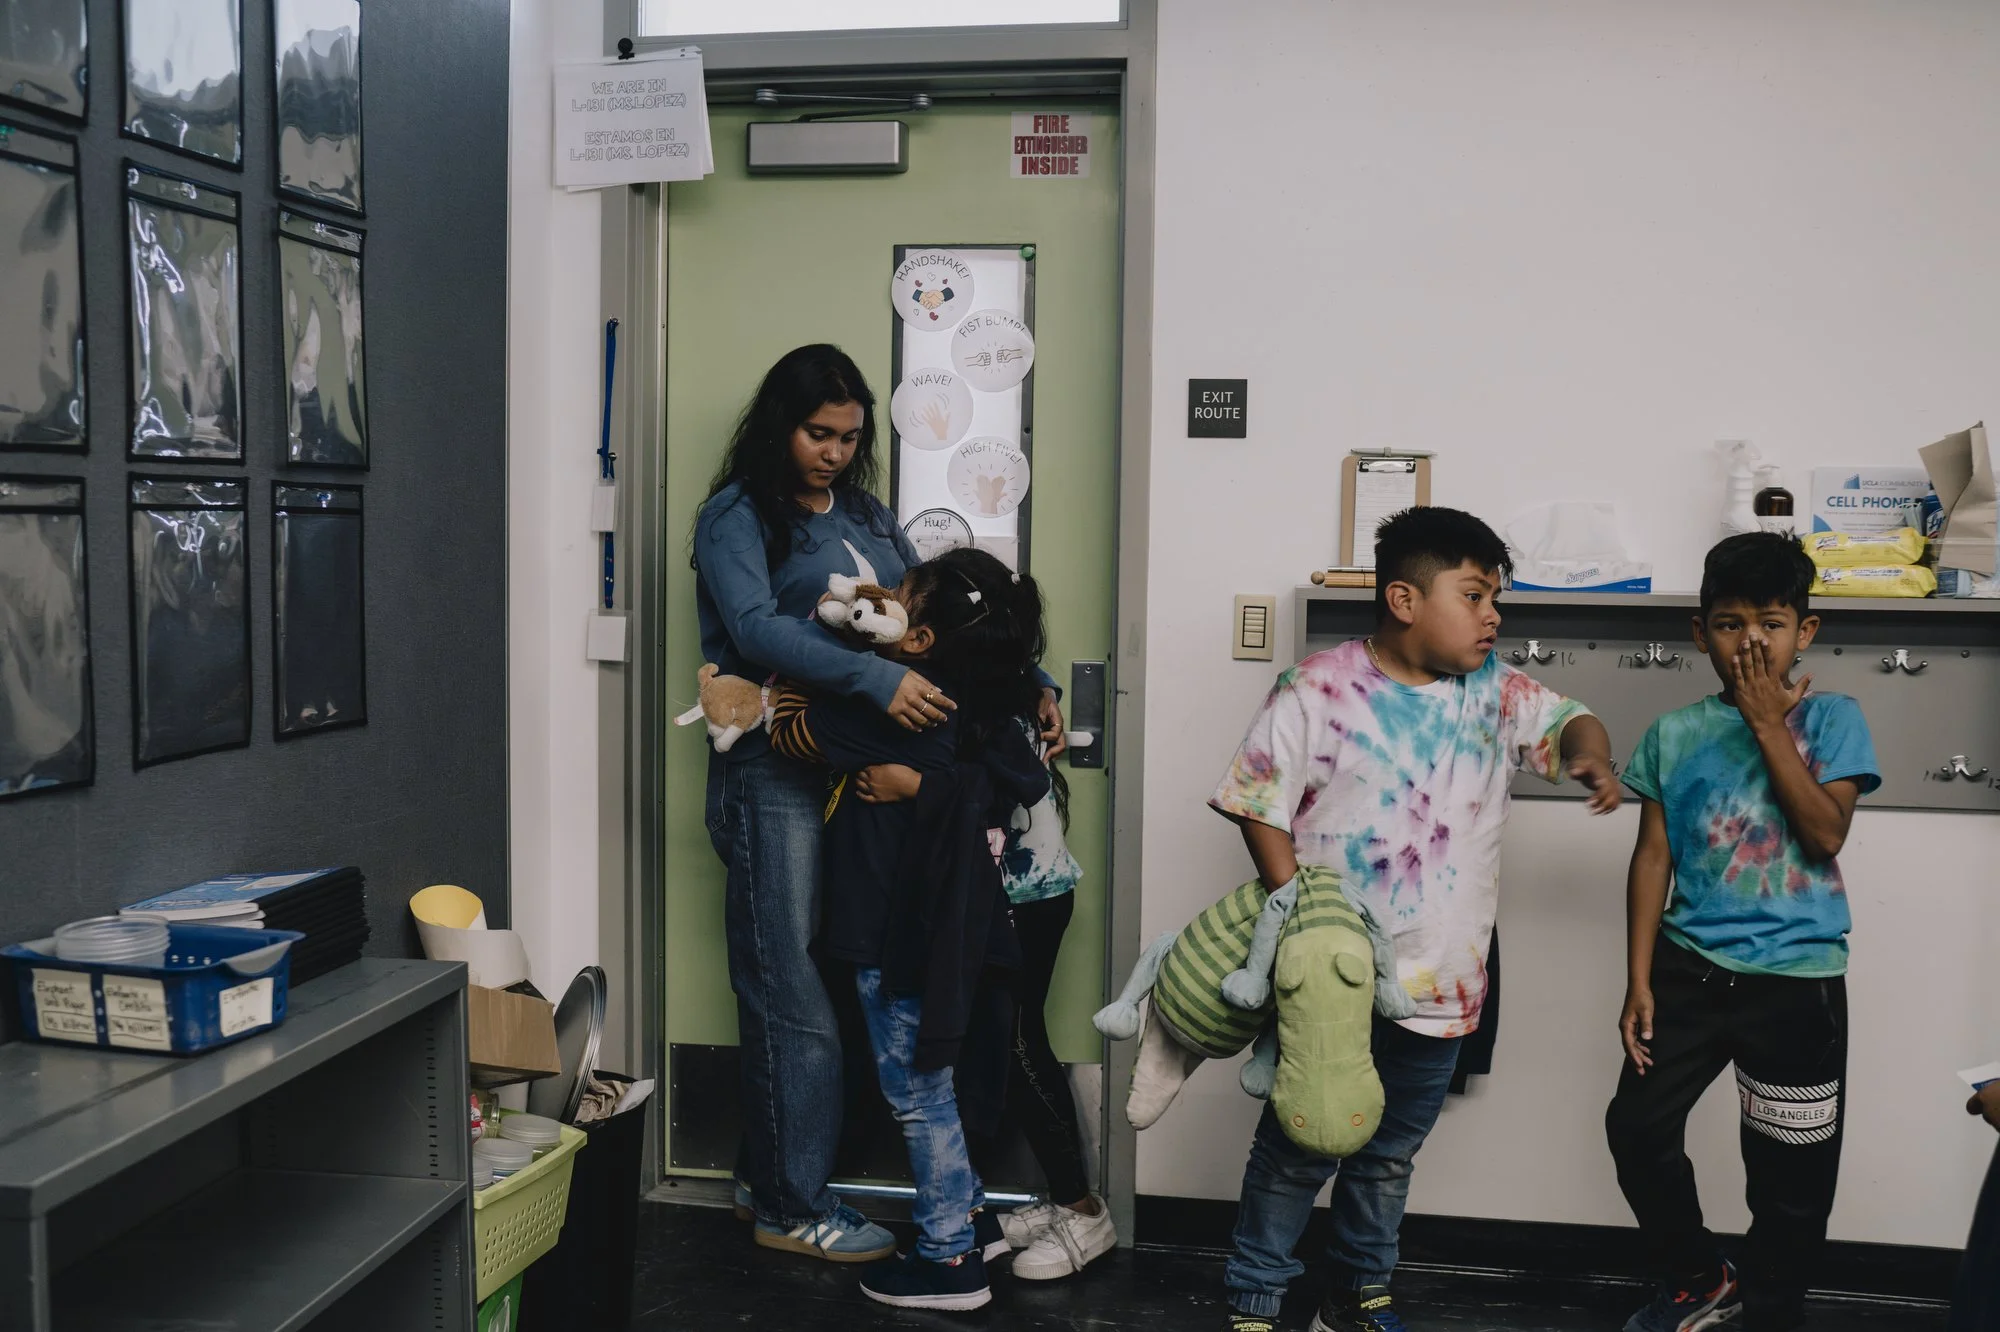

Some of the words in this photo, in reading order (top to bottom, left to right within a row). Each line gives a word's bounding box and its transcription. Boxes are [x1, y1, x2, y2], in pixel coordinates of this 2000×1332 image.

[592, 81, 613, 94] WE
[617, 80, 645, 94] ARE
[648, 79, 666, 91] IN
[1034, 115, 1069, 133] FIRE
[585, 129, 653, 145] ESTAMOS
[656, 128, 675, 141] EN
[1014, 135, 1088, 154] EXTINGUISHER
[637, 143, 689, 159] LOPEZ)
[1022, 156, 1079, 175] INSIDE
[896, 254, 969, 281] HANDSHAKE!
[958, 318, 982, 337] FIST
[985, 316, 1025, 333] BUMP!
[911, 374, 953, 387] WAVE!
[1203, 391, 1234, 403] EXIT
[1195, 407, 1240, 419] ROUTE
[960, 441, 992, 458] HIGH
[994, 443, 1022, 464] FIVE!
[1827, 496, 1858, 508] CELL
[1863, 497, 1911, 509] PHONE
[924, 516, 951, 531] Hug!
[1562, 652, 1575, 667] 16
[1618, 654, 1632, 669] 17
[1757, 1103, 1777, 1118] LOS
[1779, 1108, 1826, 1121] ANGELES
